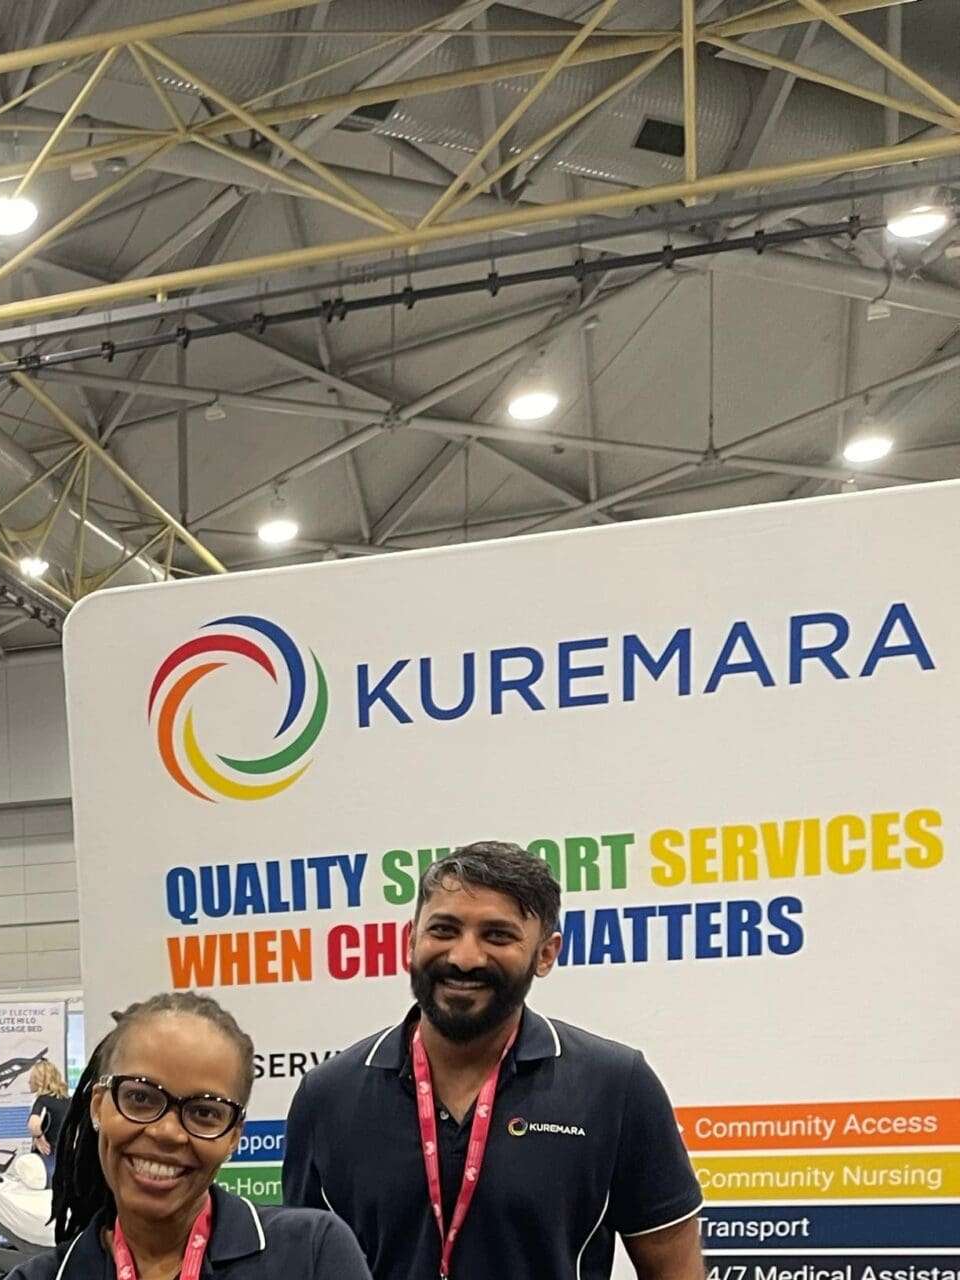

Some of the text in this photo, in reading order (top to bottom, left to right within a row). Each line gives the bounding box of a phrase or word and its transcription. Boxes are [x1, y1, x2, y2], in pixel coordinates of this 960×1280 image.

[356, 602, 936, 729] KUREMARA
[165, 808, 944, 926] QUALITY SORT SERVICES
[166, 927, 313, 989] WHEN
[556, 896, 804, 967] MATTERS
[9, 1008, 46, 1017] ELECTRIC
[253, 1050, 341, 1079] SERV
[529, 1122, 586, 1136] KUREMARA
[694, 1113, 939, 1141] Community Access
[237, 1134, 286, 1156] ppor
[695, 1163, 942, 1191] Community Nursing
[696, 1216, 810, 1241] Transport
